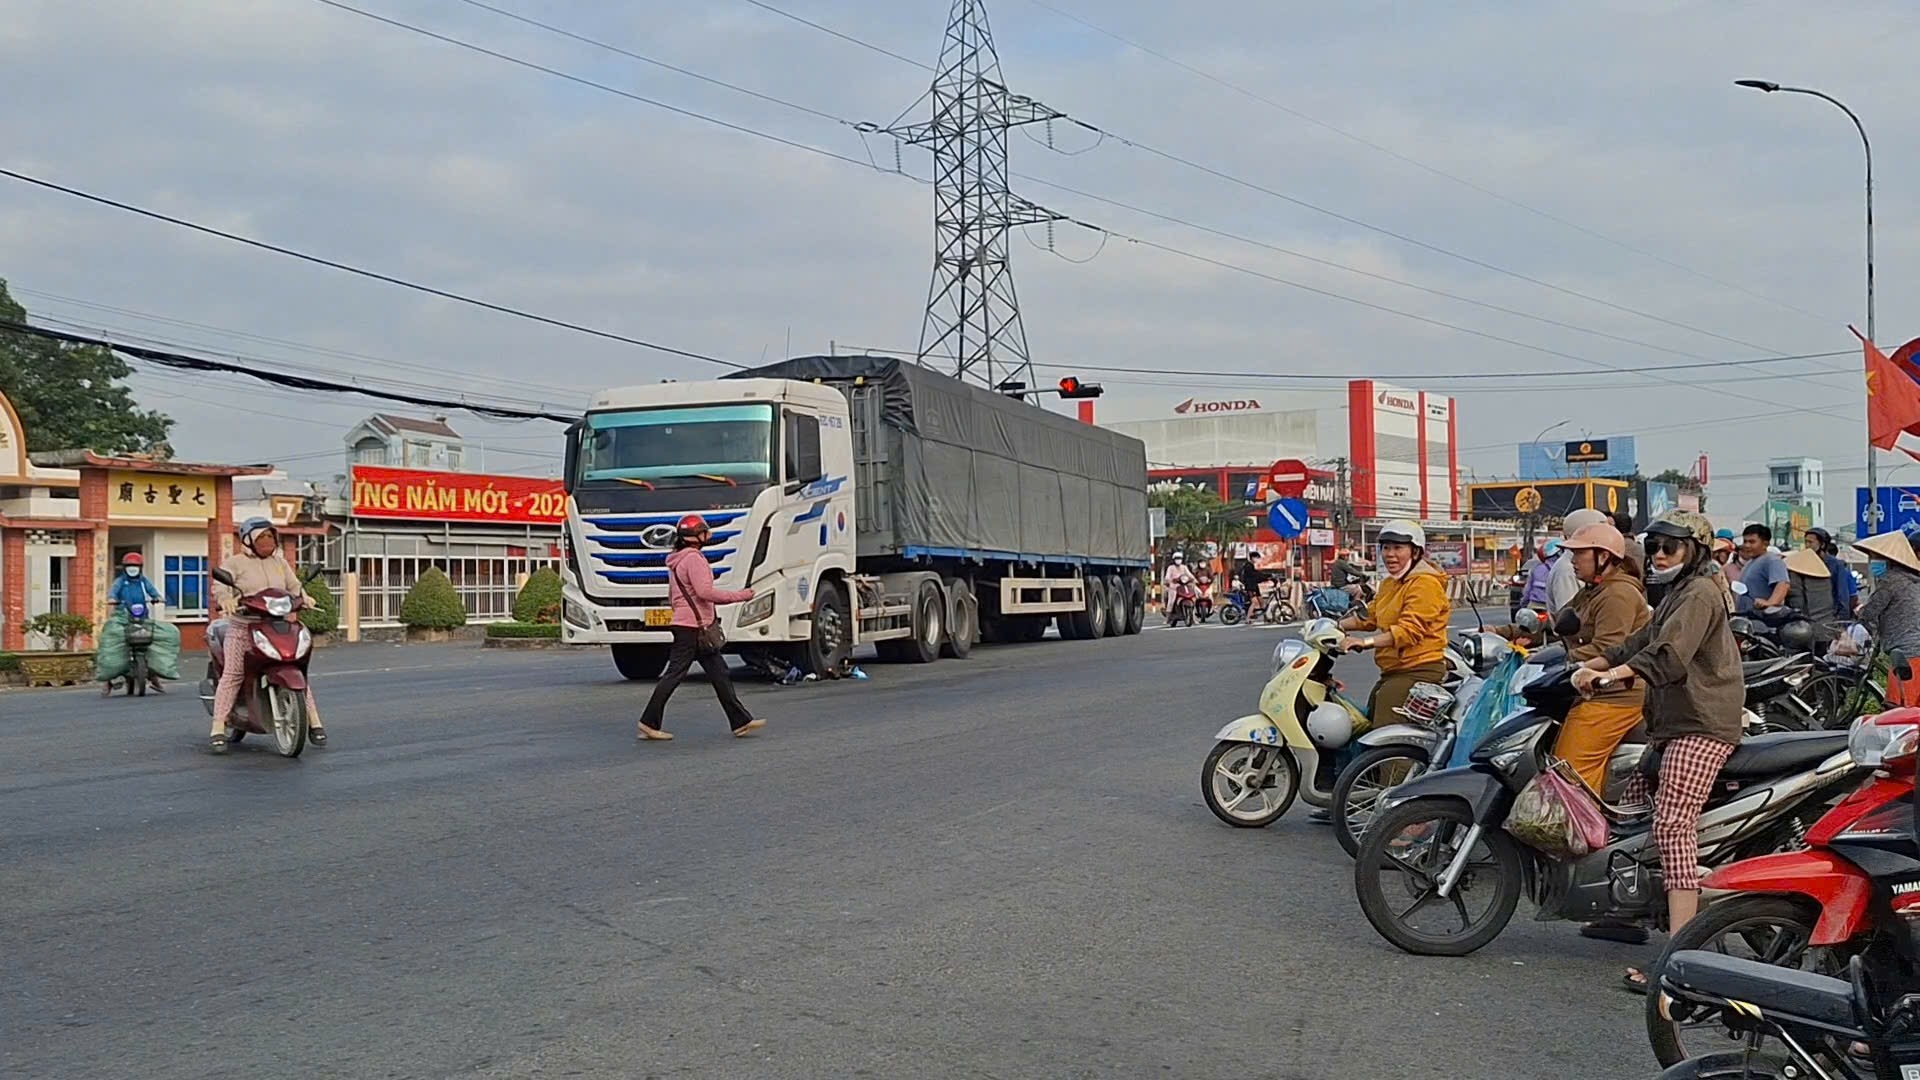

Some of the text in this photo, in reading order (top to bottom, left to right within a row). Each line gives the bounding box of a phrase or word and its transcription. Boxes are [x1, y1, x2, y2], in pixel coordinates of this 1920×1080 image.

[1195, 400, 1261, 412] HONDA
[1386, 396, 1415, 410] HONDA
[406, 480, 456, 512] NĂM
[464, 482, 508, 514] MỚI
[1891, 881, 1920, 895] YAMA
